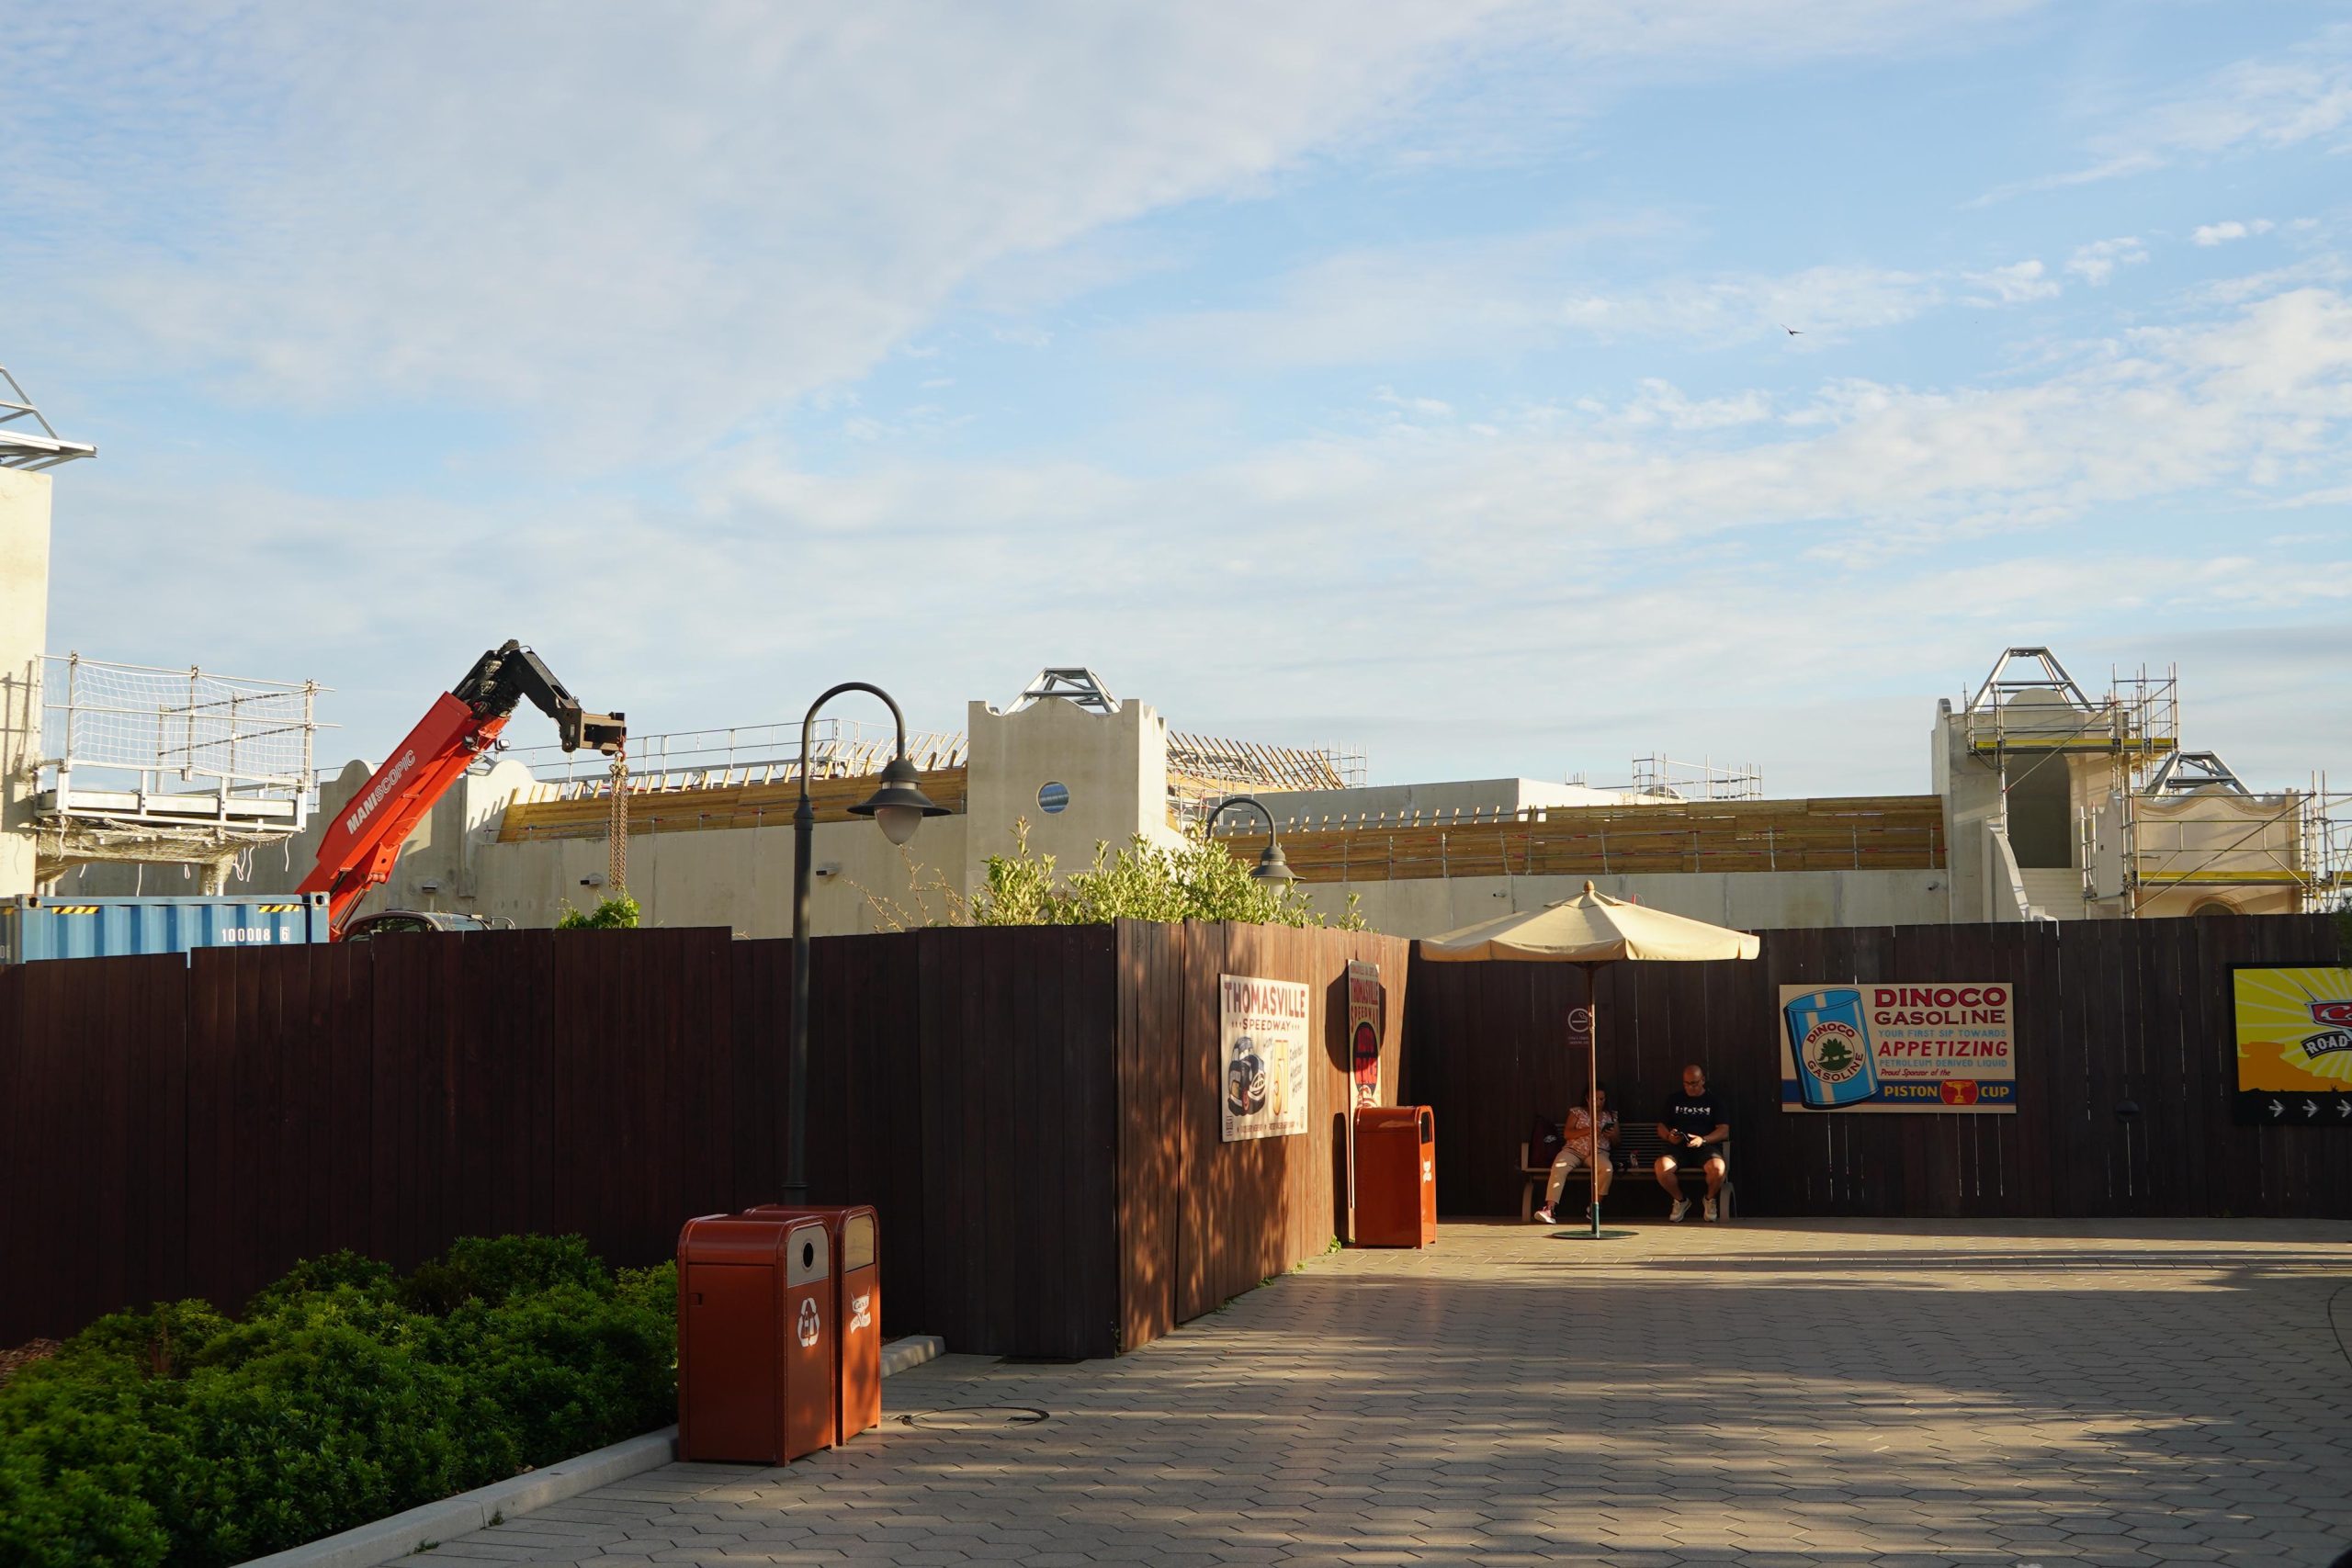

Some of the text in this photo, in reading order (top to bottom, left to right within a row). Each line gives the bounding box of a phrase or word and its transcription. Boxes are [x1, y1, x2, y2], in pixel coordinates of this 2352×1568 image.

[346, 749, 416, 835] MANISCOPIC
[221, 928, 271, 942] 100008
[1224, 982, 1306, 1018] THOMASVILLE
[1874, 987, 2007, 1008] DINOCO
[1242, 1019, 1291, 1031] SPEEDWAY
[1874, 1010, 2006, 1025] GASOLINE
[1806, 1022, 1856, 1043] DINOCO
[1878, 1029, 2007, 1038] YOUR FIRST SIP TOWARDS
[1878, 1041, 2007, 1056] APPETIZING
[2305, 1035, 2348, 1055] ROAD
[1807, 1053, 1863, 1082] GASOLINE
[1879, 1059, 2007, 1067] PETROLEUM DERIVED LIQUID
[1880, 1068, 1951, 1077] Proud Sponsor of the
[1884, 1086, 2009, 1098] PISTON CUP
